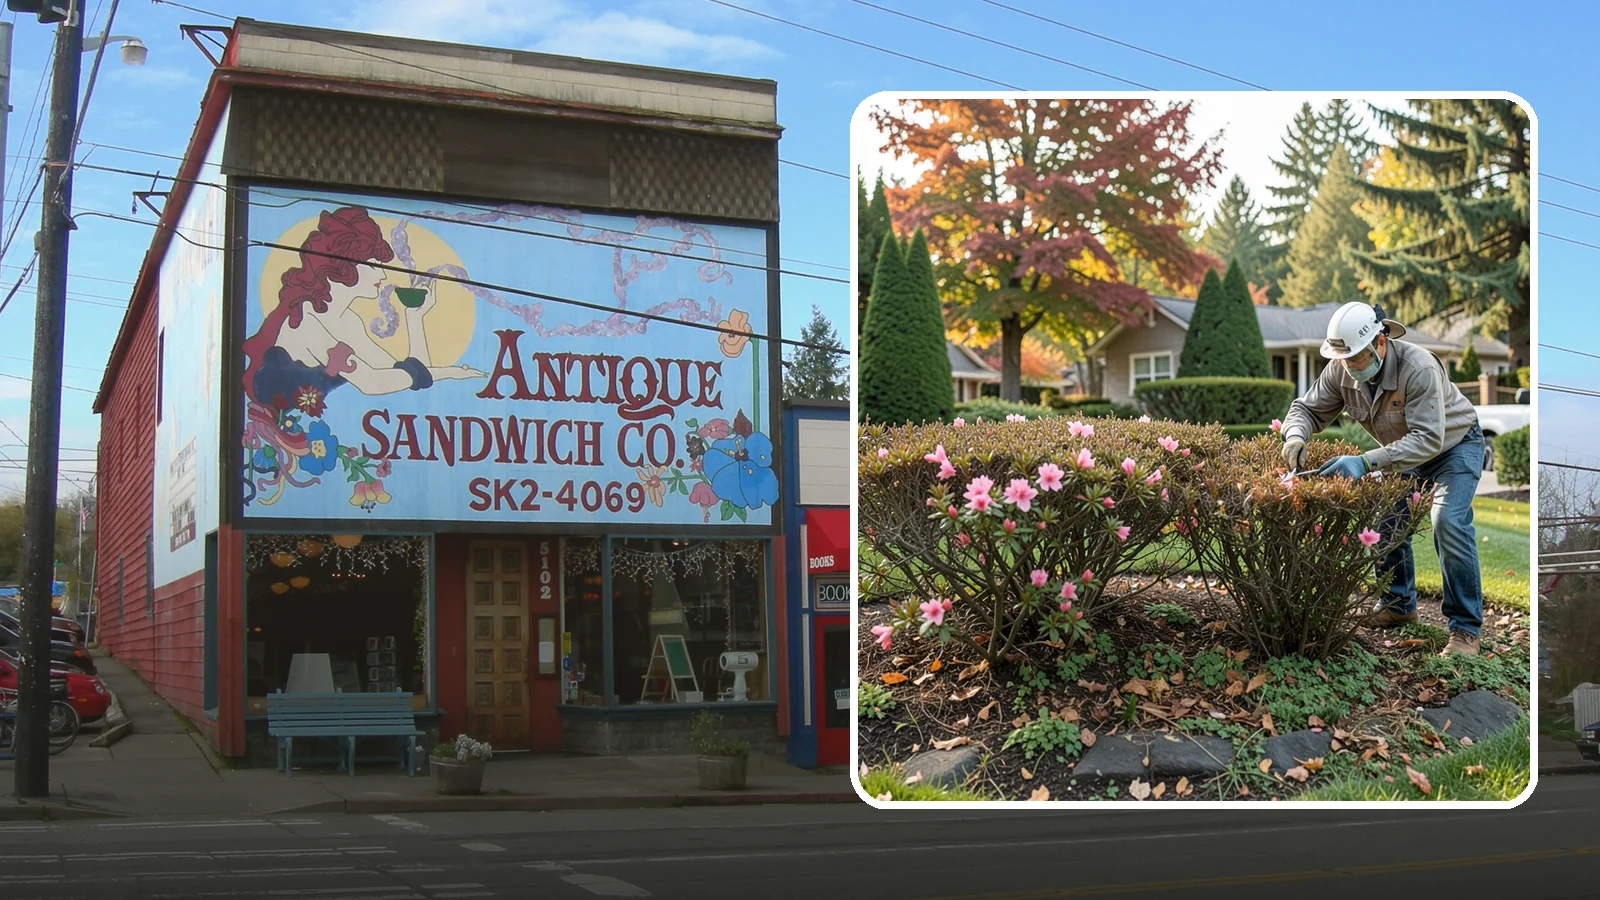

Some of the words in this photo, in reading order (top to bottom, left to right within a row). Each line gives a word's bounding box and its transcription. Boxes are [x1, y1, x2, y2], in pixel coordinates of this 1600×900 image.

[476, 329, 723, 420] ANTIQUE
[361, 409, 604, 467] SANDWICH
[617, 422, 685, 468] CO.
[468, 477, 645, 513] SK2-4069
[540, 542, 551, 599] 5102
[809, 555, 835, 569] BOOKS
